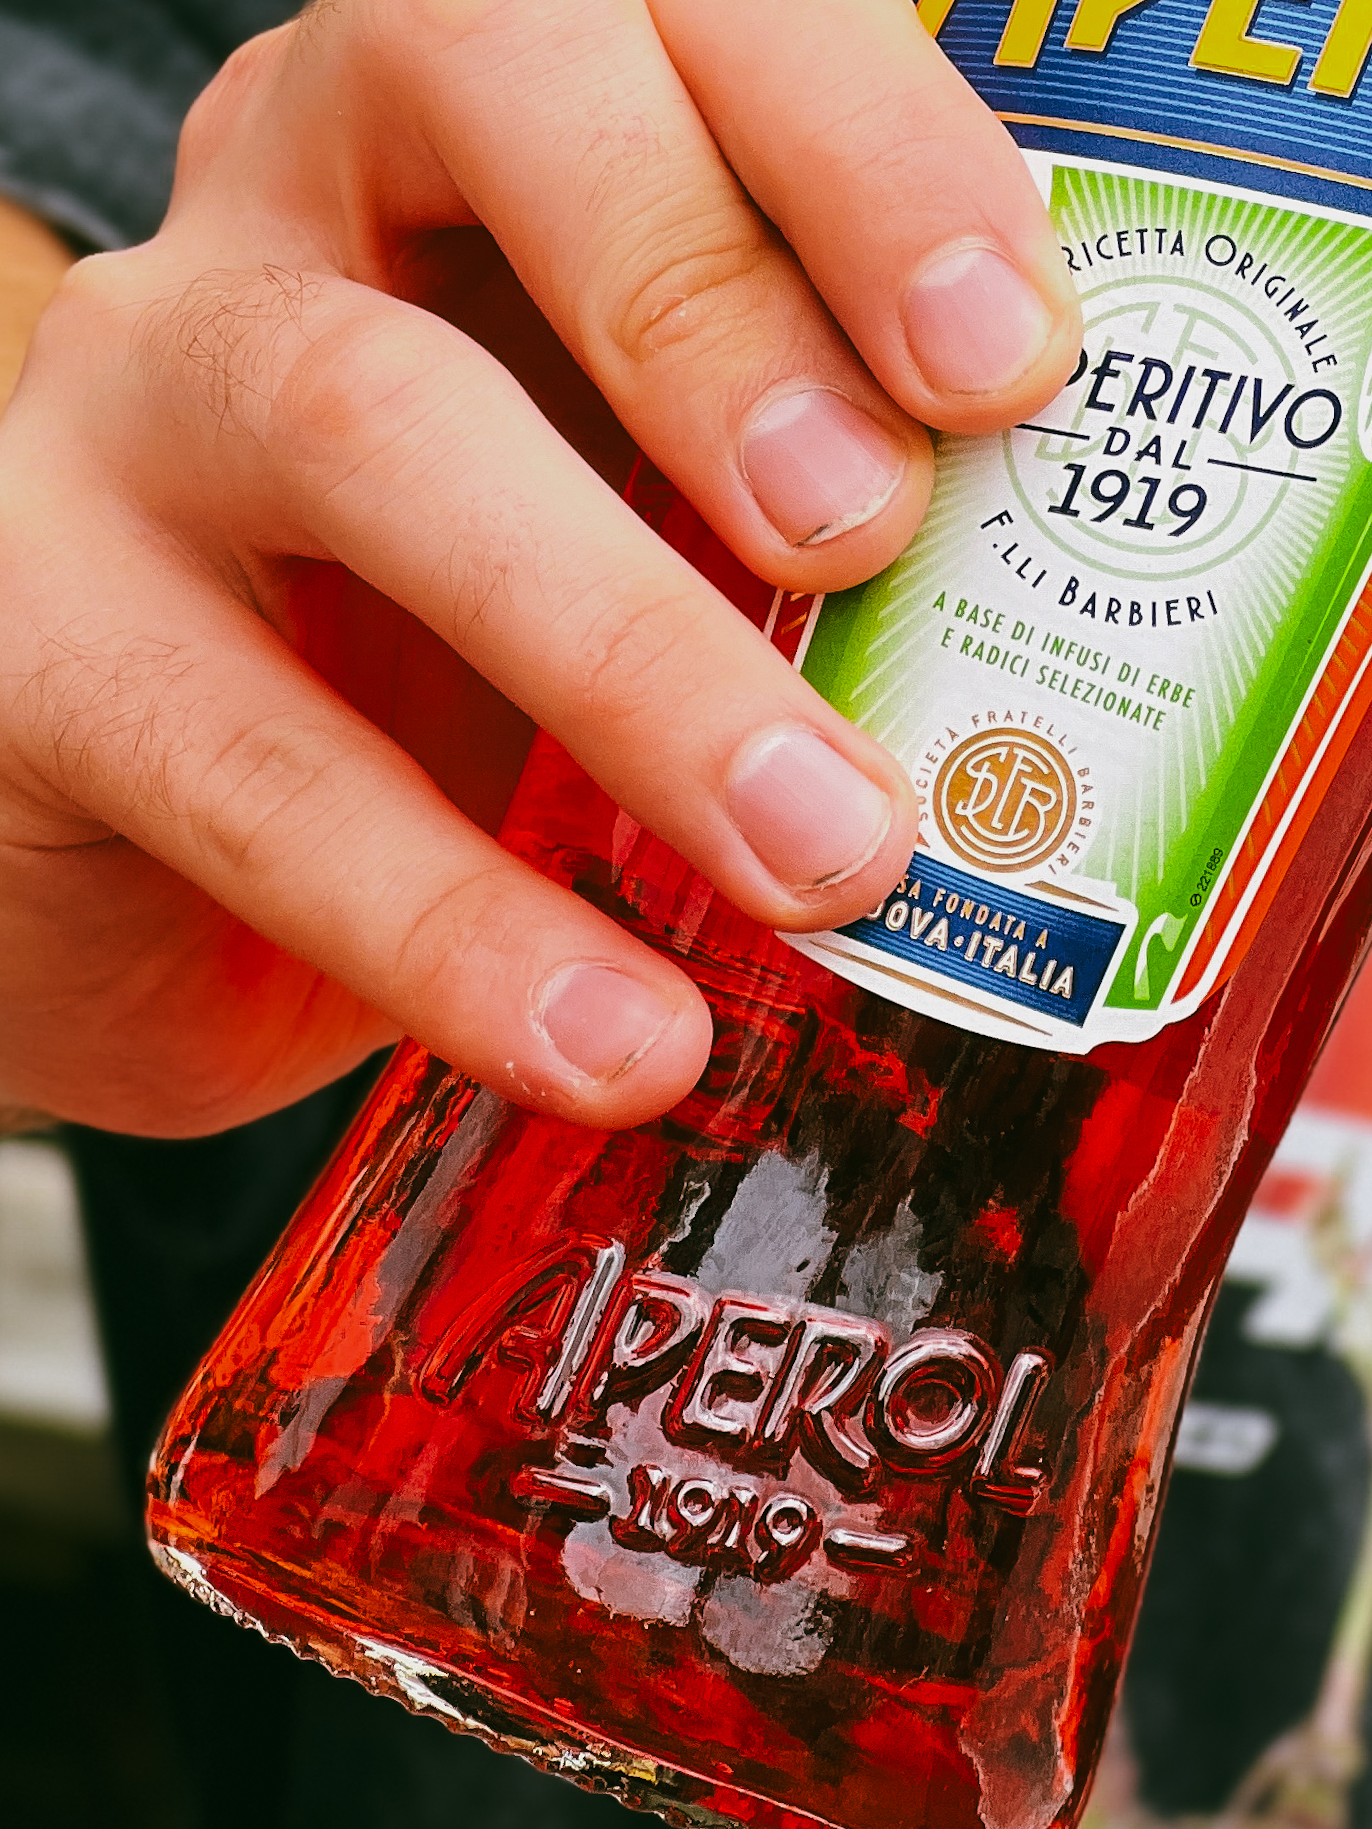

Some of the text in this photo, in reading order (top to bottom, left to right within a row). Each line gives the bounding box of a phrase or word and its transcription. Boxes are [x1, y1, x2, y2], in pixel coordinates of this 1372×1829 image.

[1061, 228, 1338, 374] RICETTA ORIGINALE
[1065, 348, 1342, 450] ERITIVO
[1103, 426, 1192, 471] DAL
[1048, 463, 1208, 537] 1919
[980, 509, 1218, 628] F.LLI BARBIERI
[933, 591, 1196, 709] A BASE DI INFUSI DI ERBE
[941, 627, 1167, 731] E RADICI SELEZIONATE
[971, 710, 1078, 755] FRATELLI
[1047, 767, 1095, 875] BARBIERI
[933, 887, 1027, 941] FONDATA
[1035, 928, 1049, 950] A
[414, 1229, 1054, 1517] APEROL
